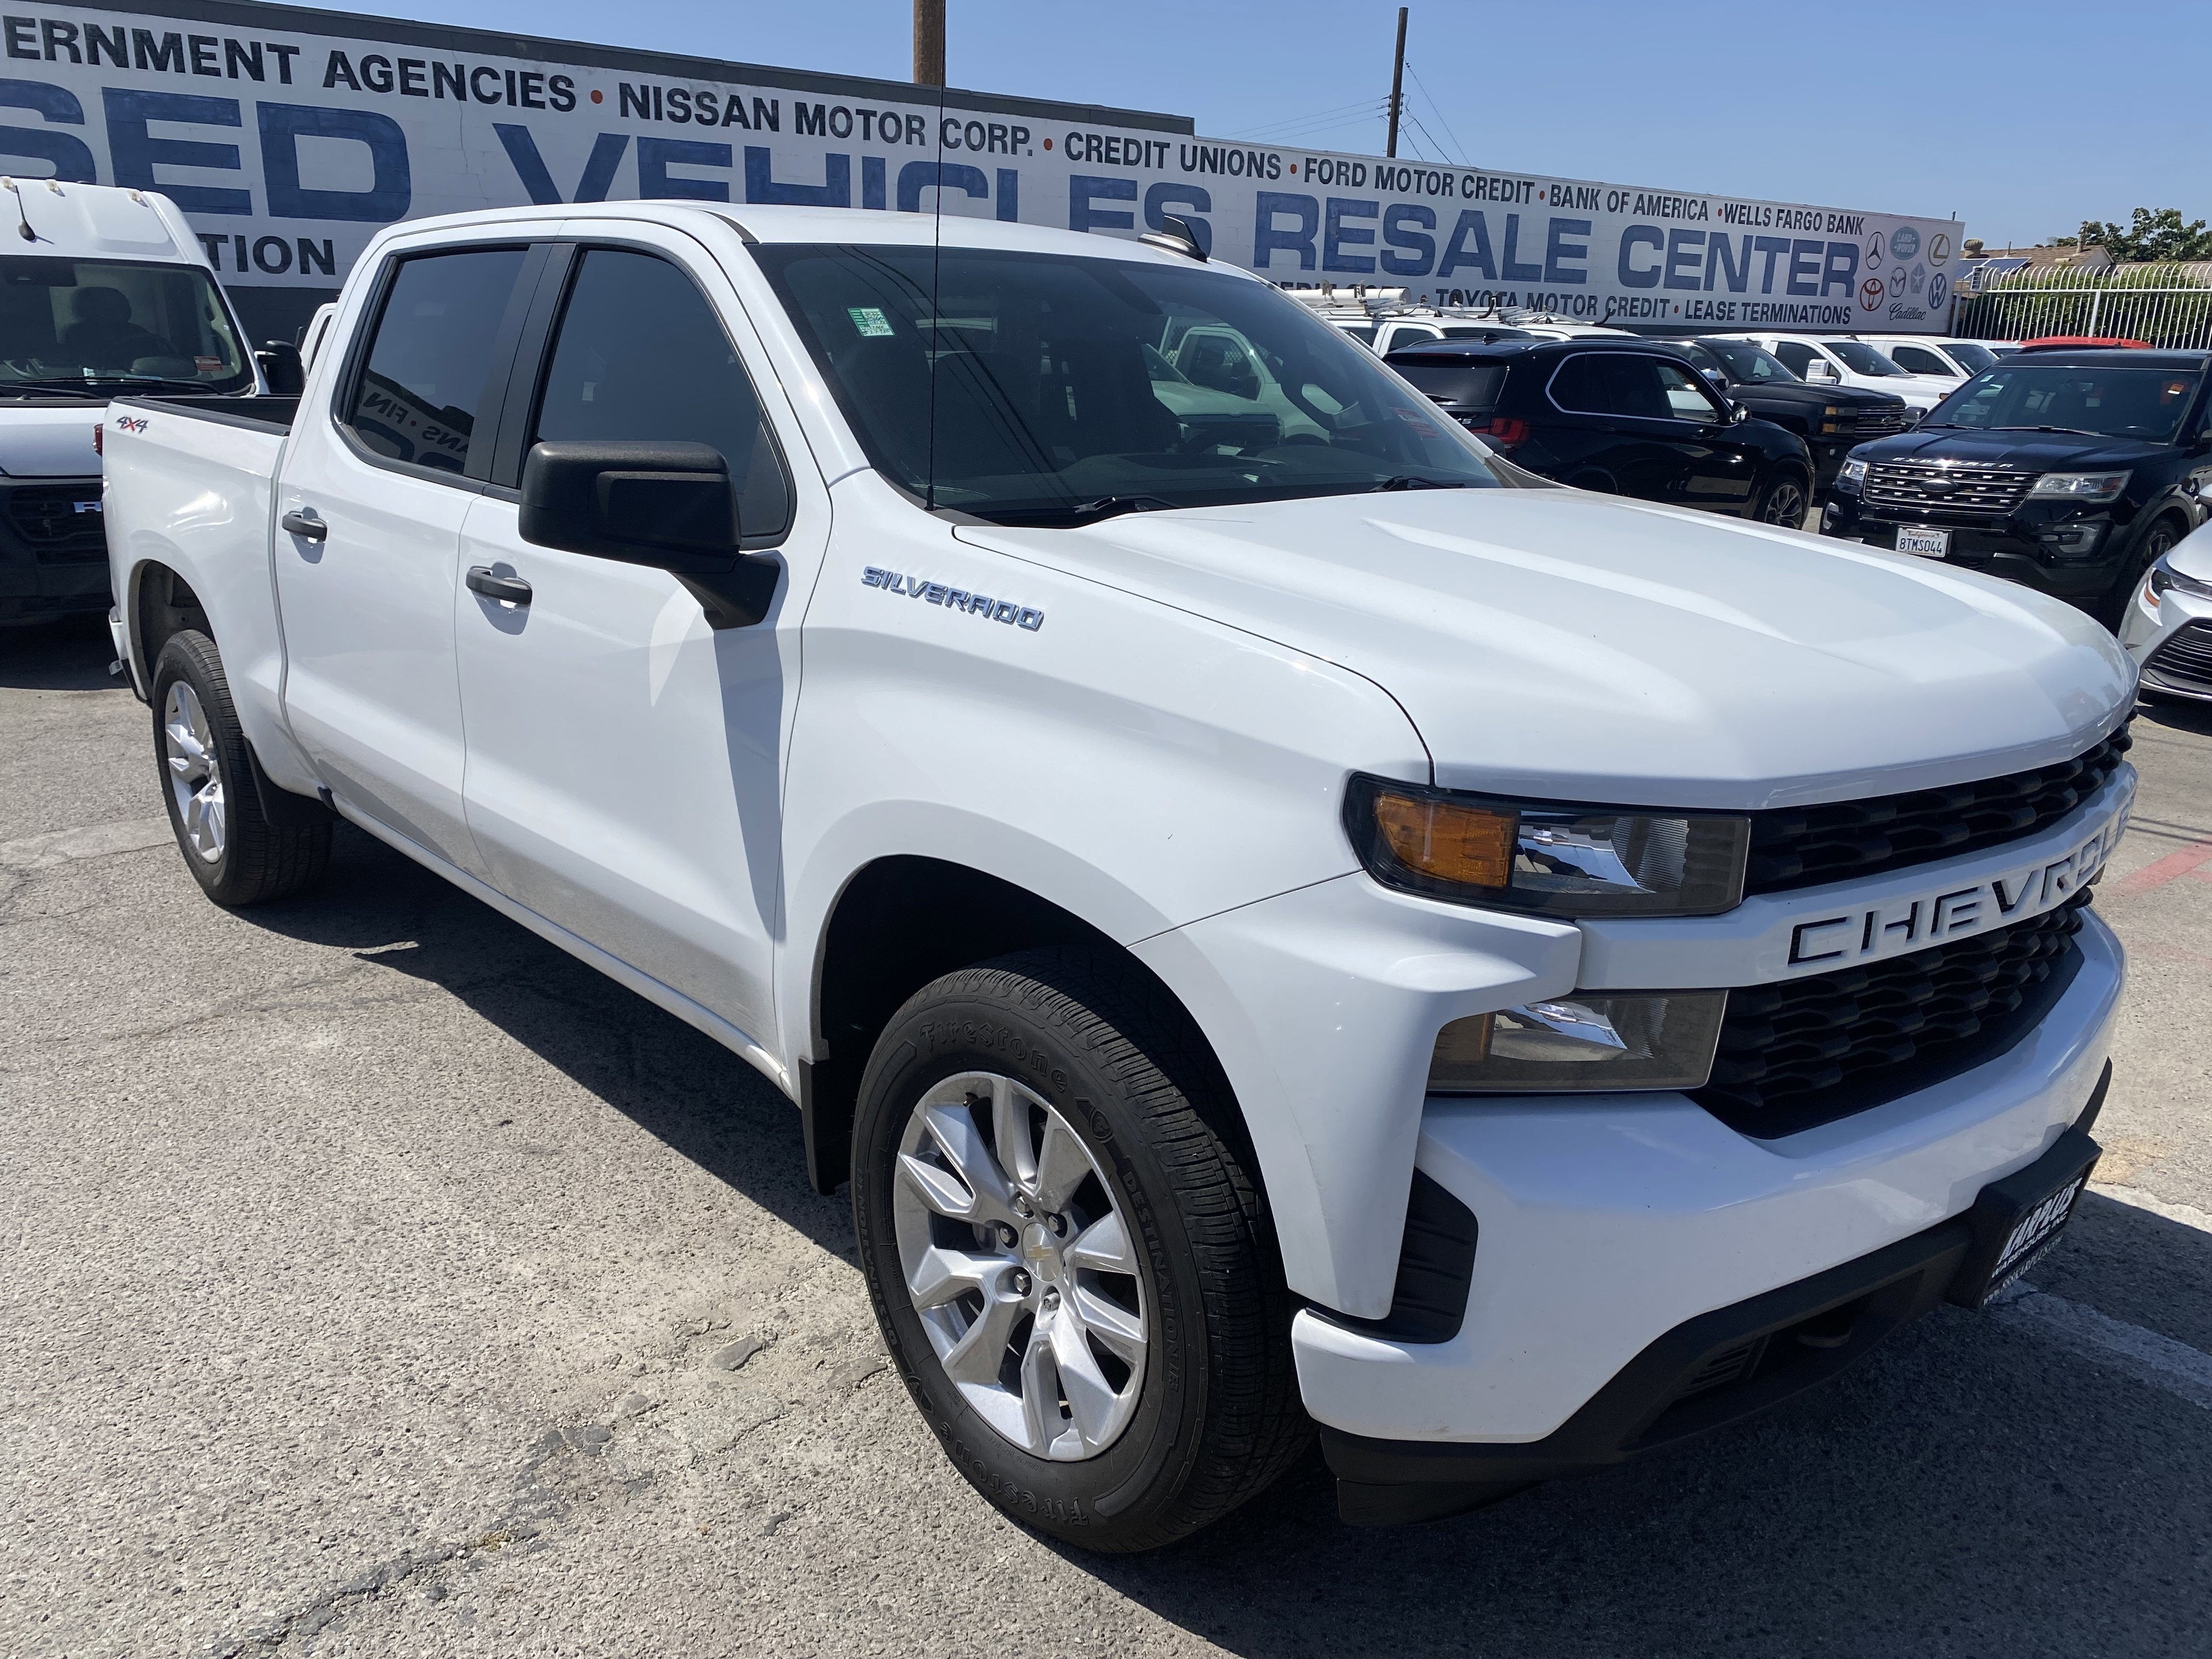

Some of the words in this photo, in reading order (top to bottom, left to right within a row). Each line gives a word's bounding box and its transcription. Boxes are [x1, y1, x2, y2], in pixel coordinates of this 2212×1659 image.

[3, 15, 300, 84] ERNMENT
[323, 49, 576, 112] AGENCIES
[619, 82, 780, 132] NISSAN
[795, 101, 926, 146] MOTOR
[941, 117, 1032, 157] CORP.
[1065, 131, 1170, 170] CREDIT
[1181, 143, 1282, 179] UNIONS
[1304, 157, 1367, 187] FORD
[1374, 165, 1454, 198] MOTOR
[1461, 174, 1535, 205] CREDIT
[1549, 184, 1601, 211] BANK
[1607, 190, 1630, 213] OF
[1633, 194, 1708, 221] AMERICA
[1724, 203, 1771, 228] WELLS
[1775, 209, 1822, 232] FARGO
[1826, 215, 1865, 235] BANK
[195, 233, 336, 275] TION
[1254, 190, 1592, 284] RESALE
[1618, 224, 1860, 298] CENTER
[1527, 292, 1598, 316] MOTOR
[1605, 295, 1670, 318] CREDIT
[1685, 300, 1737, 321] LEASE
[1741, 302, 1852, 325] TERMINATIONS
[1889, 303, 1926, 320] Cadillac
[1892, 457, 2014, 468] EXPORER
[1900, 538, 1942, 554] 8TMS044
[861, 566, 1044, 632] SILVERADO
[1787, 789, 2136, 967] CHEVROLE
[919, 1020, 1068, 1093] Firestone
[1122, 1171, 1179, 1358] DESTINATION
[939, 1422, 1088, 1526] Firestone
